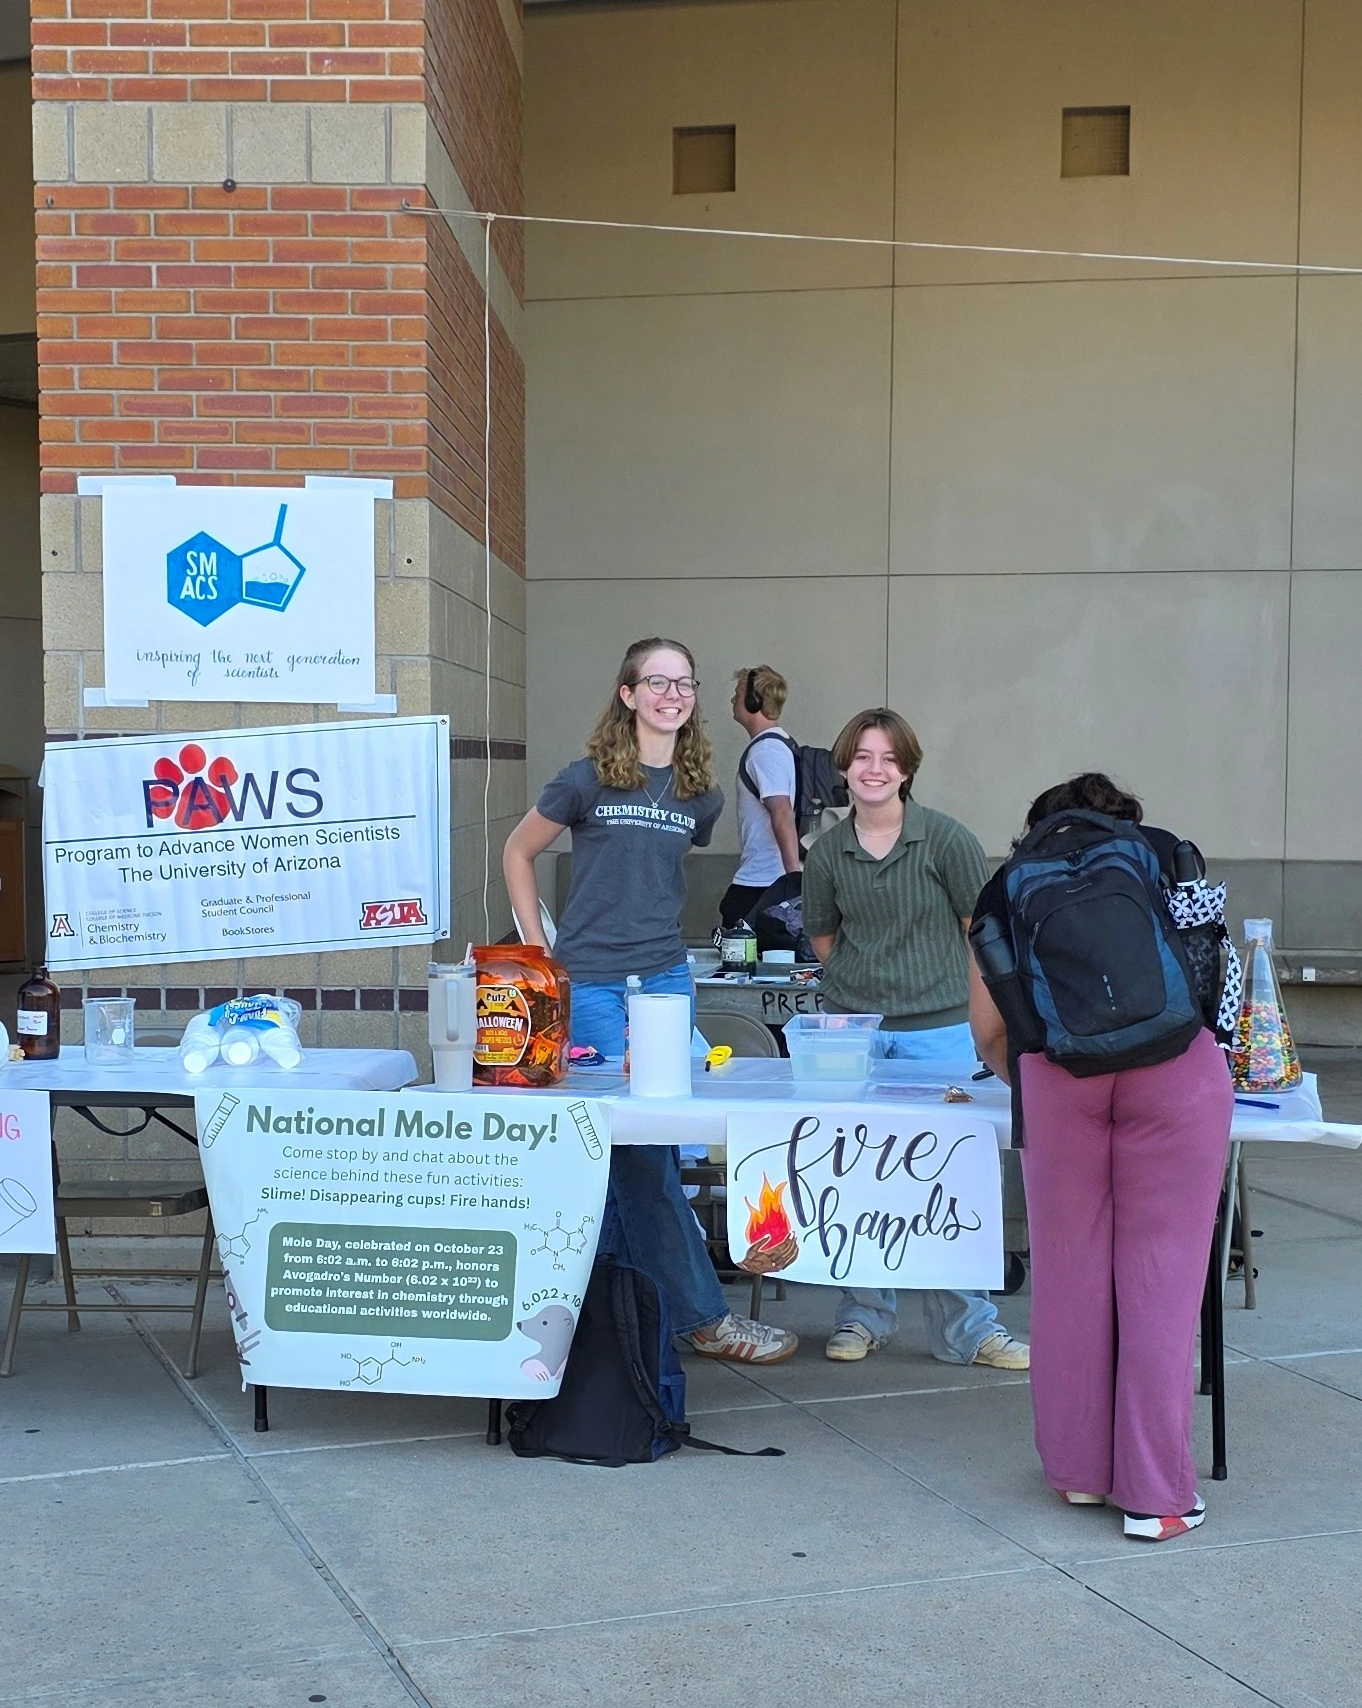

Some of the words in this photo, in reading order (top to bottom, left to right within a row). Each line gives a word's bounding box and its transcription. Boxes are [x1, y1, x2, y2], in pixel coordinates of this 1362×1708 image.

[186, 550, 217, 576] SM
[180, 575, 218, 600] ACS
[136, 649, 201, 670] inspiring
[212, 649, 233, 664] the
[245, 650, 273, 664] next
[287, 649, 361, 671] generation
[187, 665, 201, 687] of
[223, 667, 279, 679] scientists
[142, 768, 324, 828] PAWS
[595, 804, 670, 821] CHEMISTRY
[670, 812, 696, 830] CLUB
[55, 846, 131, 865] Program
[137, 843, 153, 858] to
[159, 839, 235, 856] Advance
[241, 834, 309, 850] Women
[315, 826, 401, 845] Scientists
[118, 866, 153, 883] The
[159, 860, 246, 881] University
[252, 857, 269, 874] of
[273, 856, 342, 873] Arizona
[200, 897, 242, 907] Graduate
[245, 895, 254, 904] &
[256, 891, 311, 903] Professional
[201, 908, 237, 918] Student
[239, 904, 274, 915] Council
[87, 922, 140, 934] Chemistry
[88, 935, 98, 945] &
[99, 932, 166, 945] Biochemistry
[222, 926, 275, 936] BookStores
[477, 1016, 524, 1032] ALLOWEEN
[246, 1104, 386, 1137] National
[394, 1109, 473, 1140] Mole
[483, 1112, 558, 1151] Day!
[282, 1145, 323, 1159] Come
[326, 1148, 358, 1163] stop
[361, 1148, 379, 1164] by
[382, 1148, 409, 1162] and
[412, 1149, 444, 1164] chat
[448, 1151, 490, 1165] about
[494, 1153, 519, 1166] the
[273, 1166, 327, 1180] science
[331, 1168, 379, 1182] behind
[384, 1169, 423, 1184] these
[426, 1171, 450, 1185] fun
[454, 1172, 524, 1188] activities:
[261, 1187, 306, 1201] Slime!
[310, 1188, 404, 1208] Disappearing
[407, 1193, 445, 1208] cups!
[450, 1193, 477, 1207] Fire
[481, 1195, 530, 1209] hands!
[282, 1236, 312, 1248] Mole
[316, 1238, 341, 1250] Day,
[345, 1239, 412, 1252] celebrated
[414, 1243, 430, 1252] on
[433, 1242, 485, 1254] October
[487, 1245, 504, 1255] 23
[283, 1252, 313, 1264] from
[316, 1254, 342, 1265] 6:02
[345, 1257, 372, 1266] a.m.
[375, 1256, 388, 1267] to
[391, 1257, 419, 1268] 6:02
[421, 1260, 453, 1272] p.m.,
[455, 1259, 500, 1272] honors
[282, 1269, 351, 1283] Avogadro's
[354, 1272, 403, 1284] Number
[405, 1274, 438, 1286] (6.02
[440, 1277, 449, 1286] x
[485, 1278, 499, 1288] to
[270, 1286, 323, 1298] promote
[325, 1287, 375, 1299] interest
[377, 1289, 389, 1300] in
[391, 1290, 456, 1305] chemistry
[459, 1293, 509, 1308] through
[522, 1287, 559, 1311] 6.022
[285, 1302, 357, 1315] educational
[360, 1305, 418, 1318] activities
[421, 1308, 492, 1322] worldwide.
